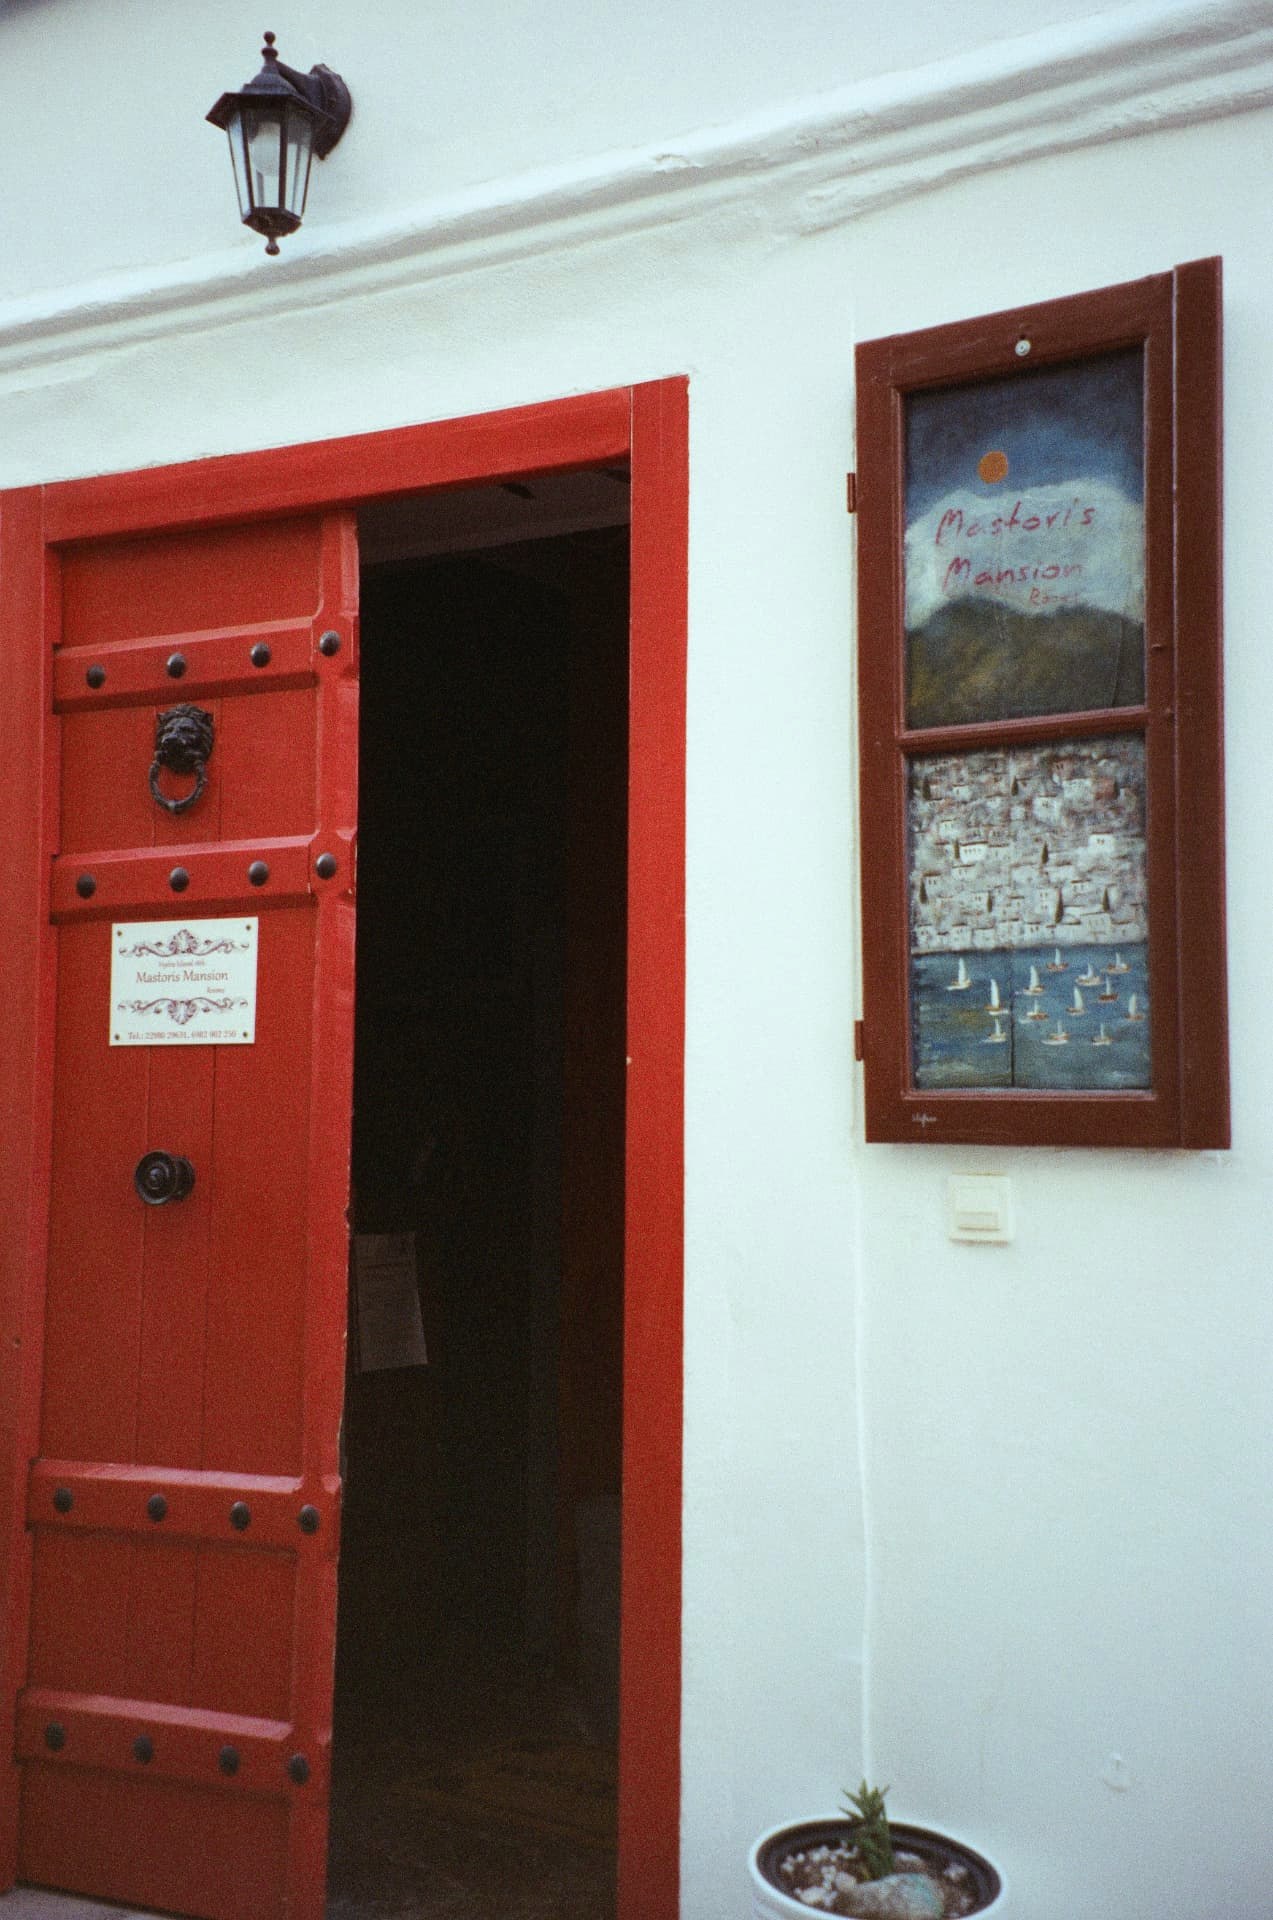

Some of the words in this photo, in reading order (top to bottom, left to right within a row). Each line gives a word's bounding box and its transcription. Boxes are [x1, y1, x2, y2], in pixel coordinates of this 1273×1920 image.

[942, 555, 1083, 593] Mansion
[136, 971, 180, 983] Mastoris
[183, 970, 228, 982] Mansion
